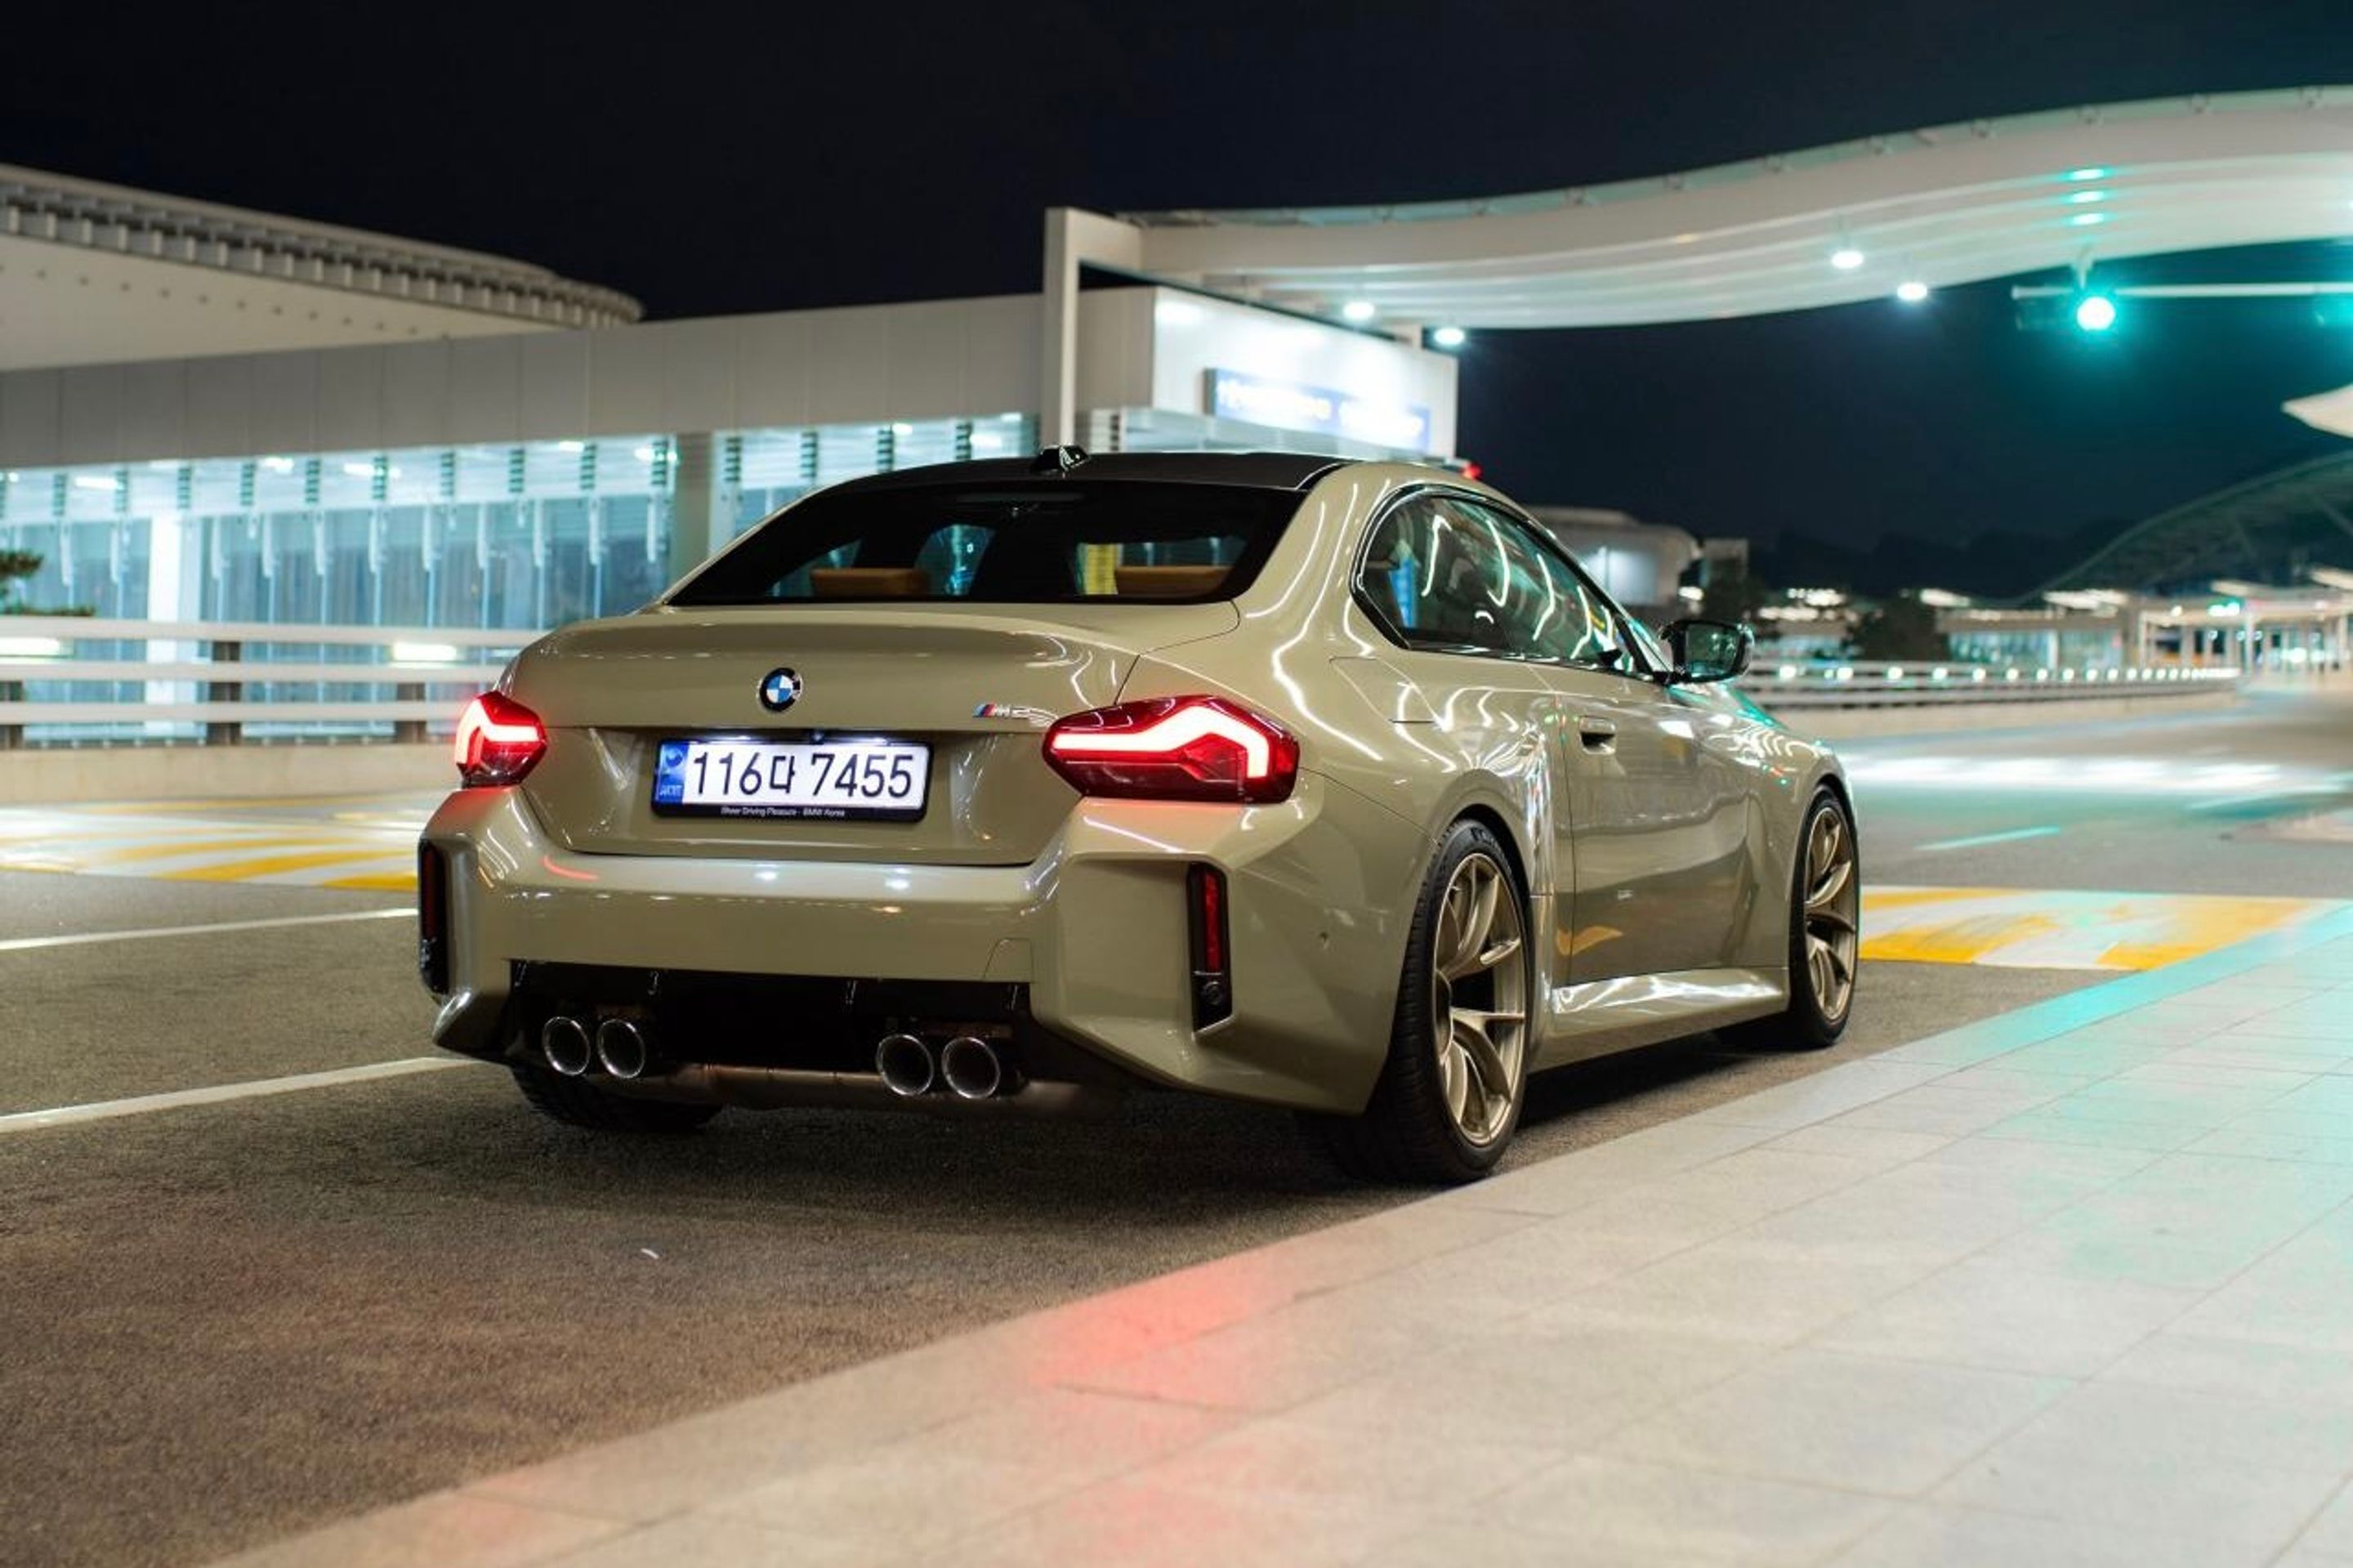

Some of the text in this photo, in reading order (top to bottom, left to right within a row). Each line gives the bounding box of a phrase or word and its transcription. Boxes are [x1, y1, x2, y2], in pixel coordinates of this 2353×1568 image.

[694, 752, 913, 797] 116다 7455
[742, 806, 766, 816] Driving
[803, 807, 822, 816] BMW
